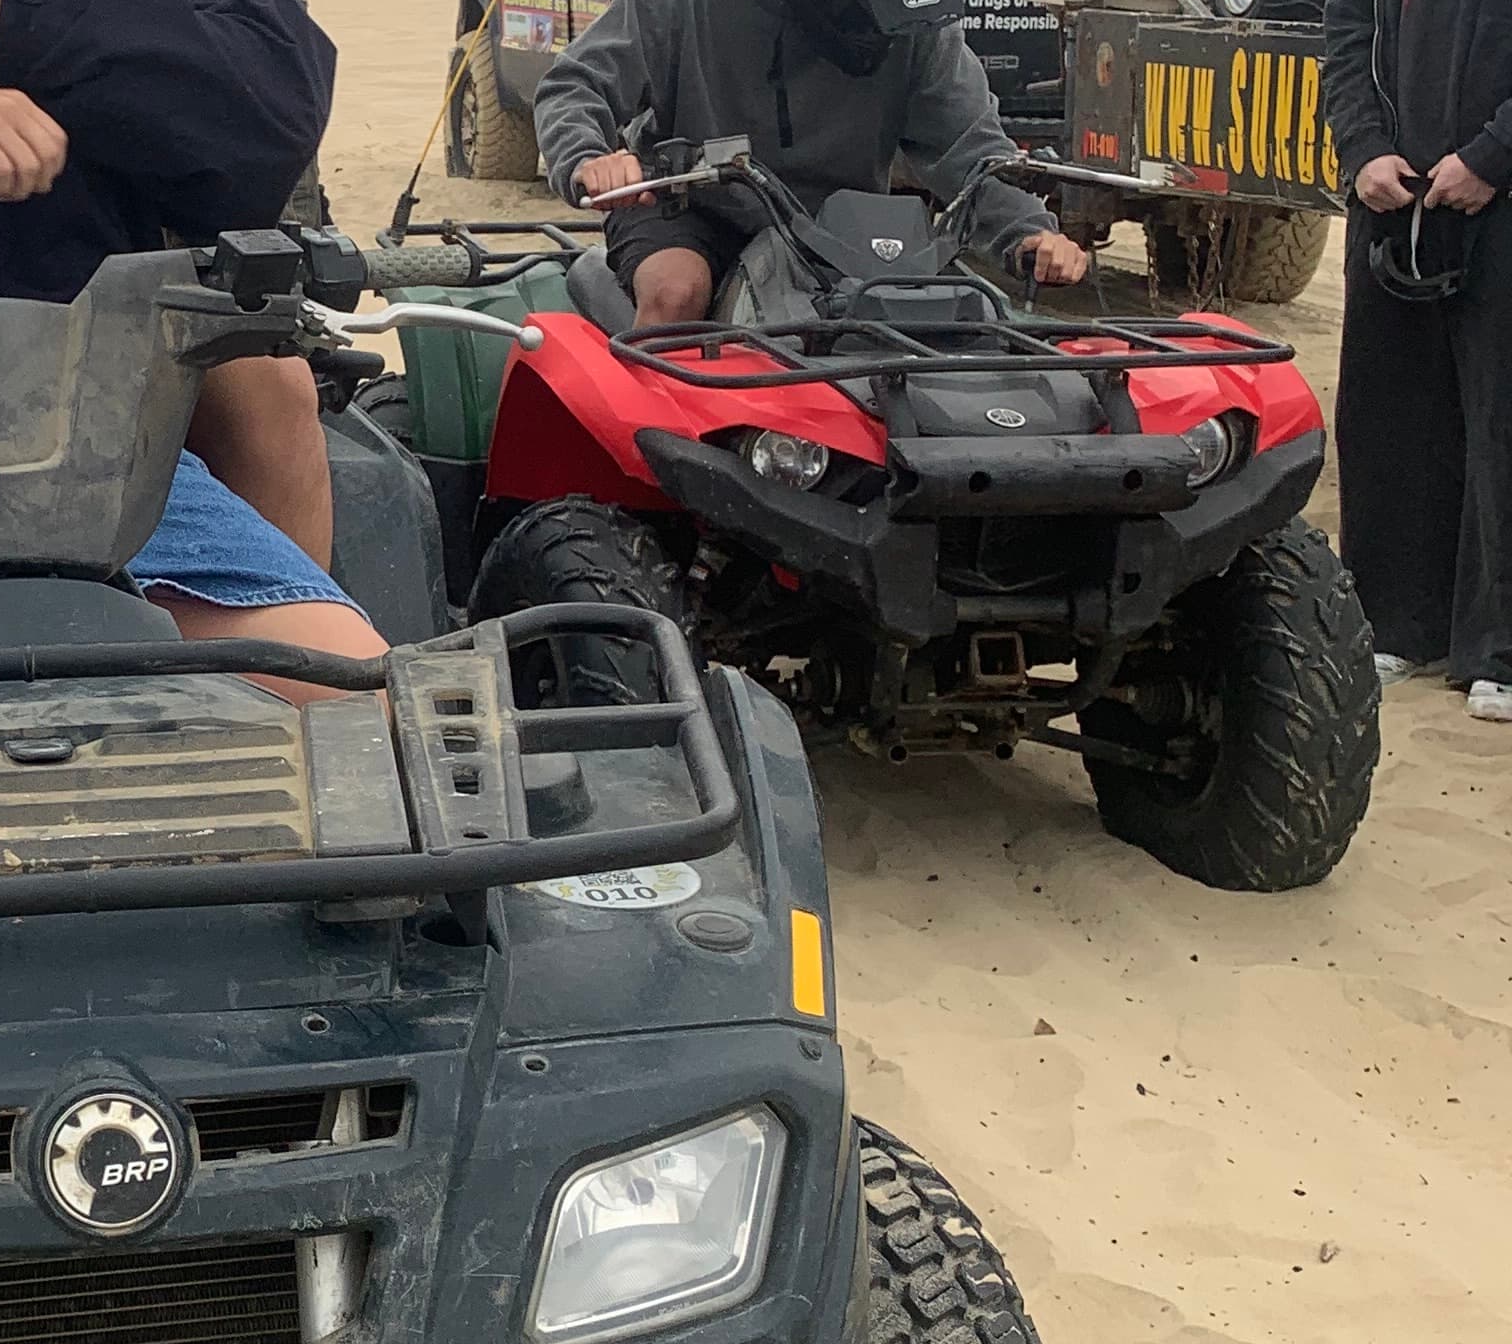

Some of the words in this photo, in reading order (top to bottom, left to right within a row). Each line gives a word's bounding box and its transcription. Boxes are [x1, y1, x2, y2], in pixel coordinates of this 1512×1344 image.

[984, 13, 1059, 33] Responsib
[584, 886, 658, 903] 010
[101, 1157, 169, 1187] BRP
